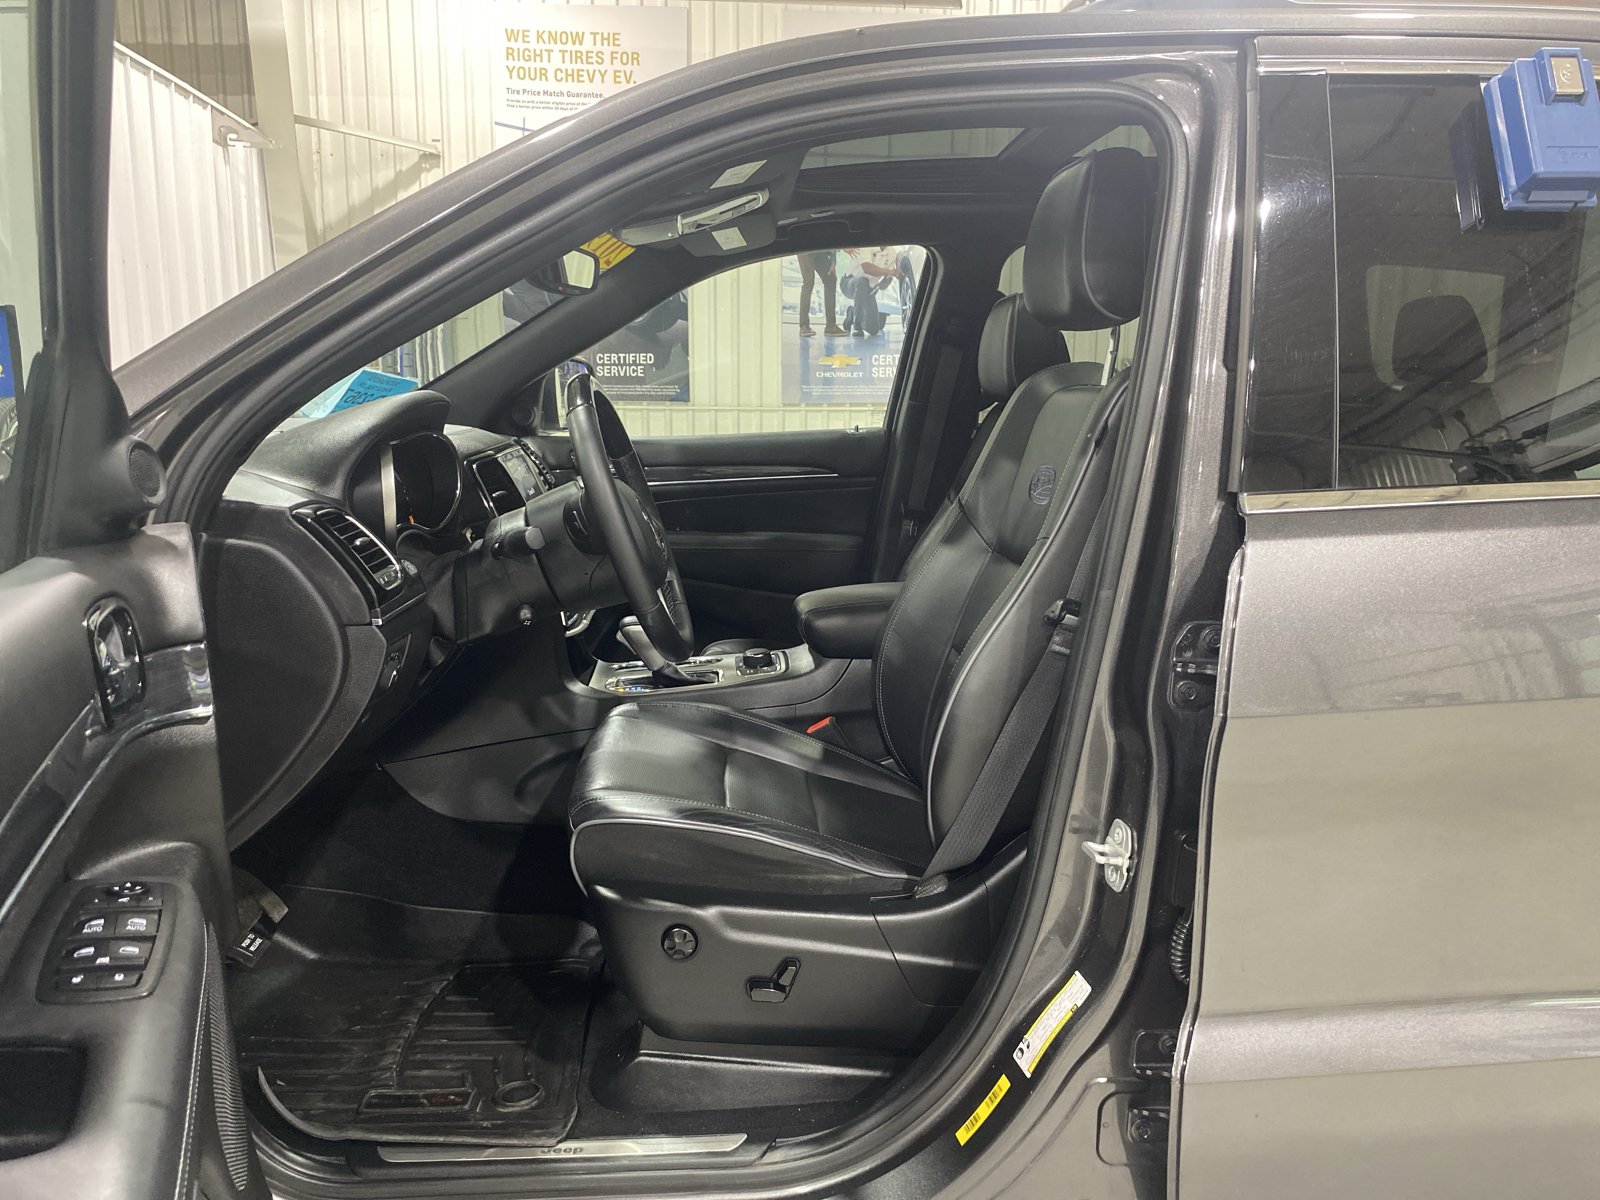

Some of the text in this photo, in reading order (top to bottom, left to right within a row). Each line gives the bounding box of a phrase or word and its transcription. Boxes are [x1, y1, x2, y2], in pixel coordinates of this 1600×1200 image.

[505, 28, 621, 47] WE KNOW THE
[506, 47, 640, 66] RIGHT TIRES FOR
[506, 65, 637, 84] YOUR CHEVY EV.
[506, 87, 605, 99] Tire Price Match Guarantee.
[596, 353, 655, 364] CERTIFIED
[596, 365, 645, 377] SERVICE
[540, 1146, 584, 1155] Jeep
